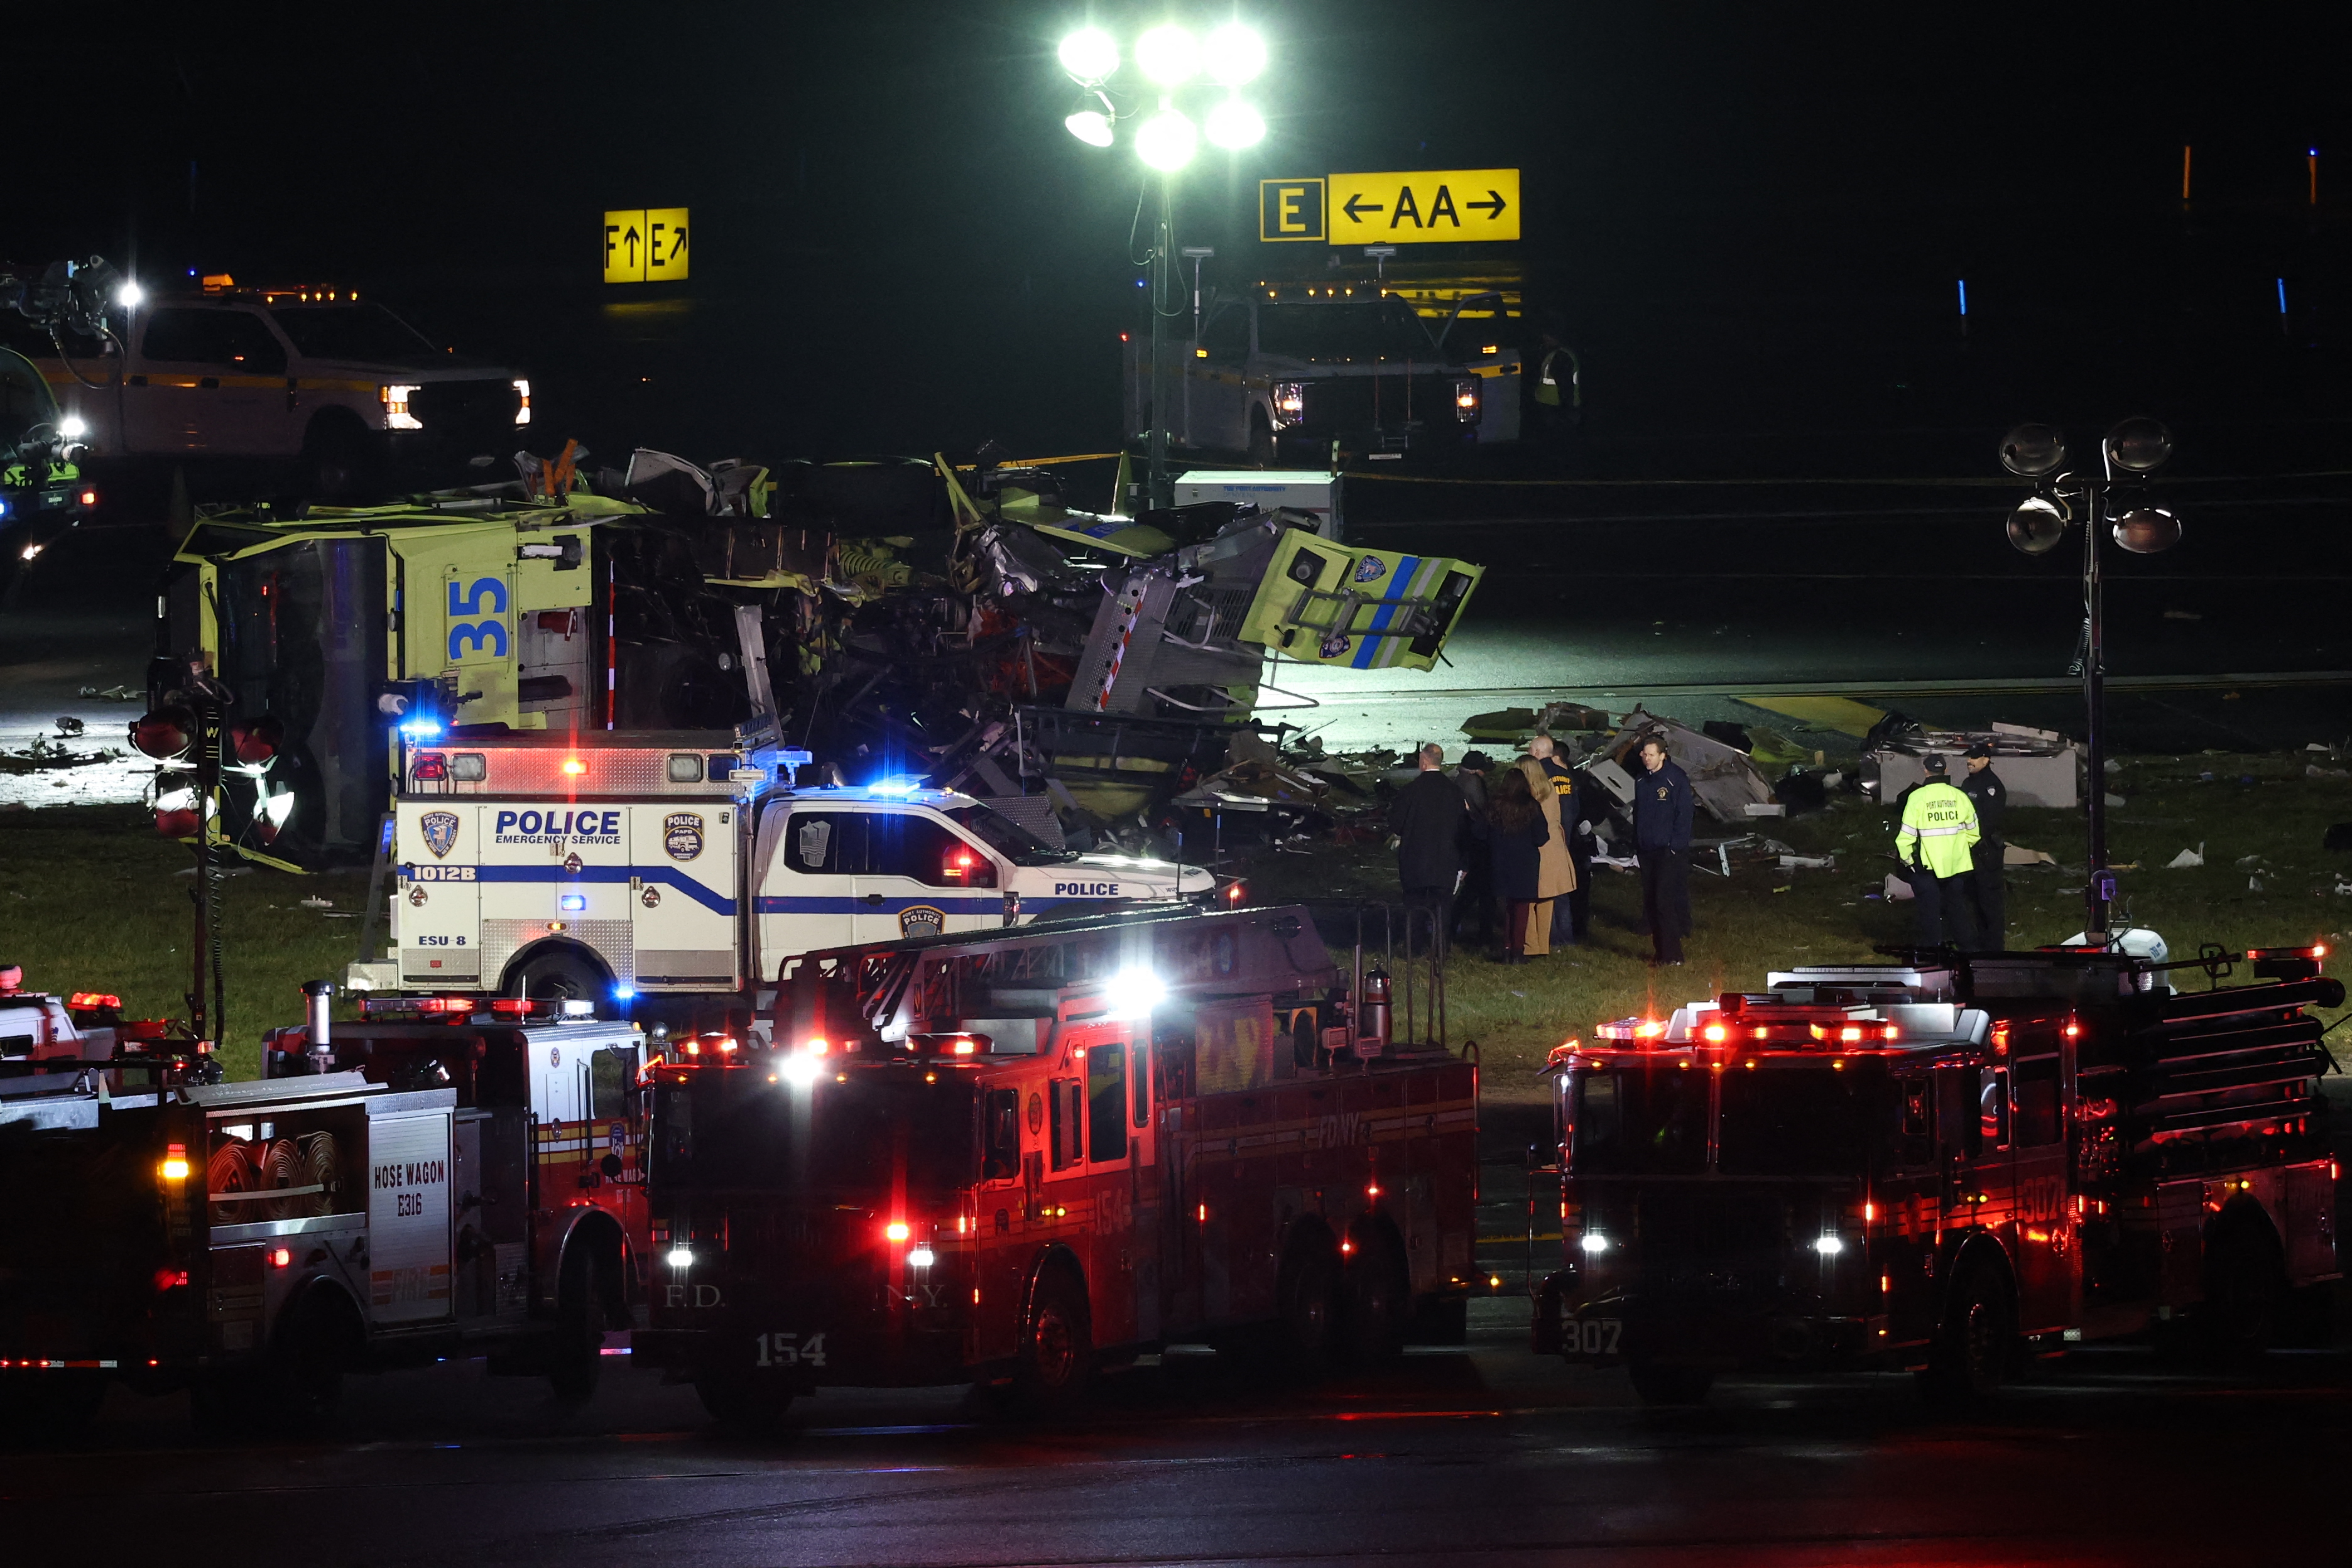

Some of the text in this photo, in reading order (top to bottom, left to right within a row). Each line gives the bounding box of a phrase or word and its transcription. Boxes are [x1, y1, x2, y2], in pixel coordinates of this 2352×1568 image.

[1278, 188, 1306, 232] E
[1390, 185, 1461, 229] AA
[605, 226, 619, 269] F
[651, 224, 665, 266] E
[449, 577, 508, 660] 35
[1555, 784, 1571, 795] LICE
[1926, 801, 1936, 810] PORT
[424, 816, 456, 827] POLICE
[496, 810, 621, 836] POLICE
[668, 816, 700, 826] POLICE
[496, 835, 621, 844] EMERGENCY SERVICE
[414, 866, 476, 881] 1012B
[1055, 883, 1119, 895] POLICE
[903, 914, 940, 925] POLICE
[916, 909, 942, 918] AUTHORITY
[1319, 1111, 1360, 1149] FDNY
[374, 1160, 444, 1189] HOSE WAGON
[398, 1192, 422, 1217] E316
[756, 1332, 826, 1366] 154
[1561, 1320, 1623, 1354] 307
